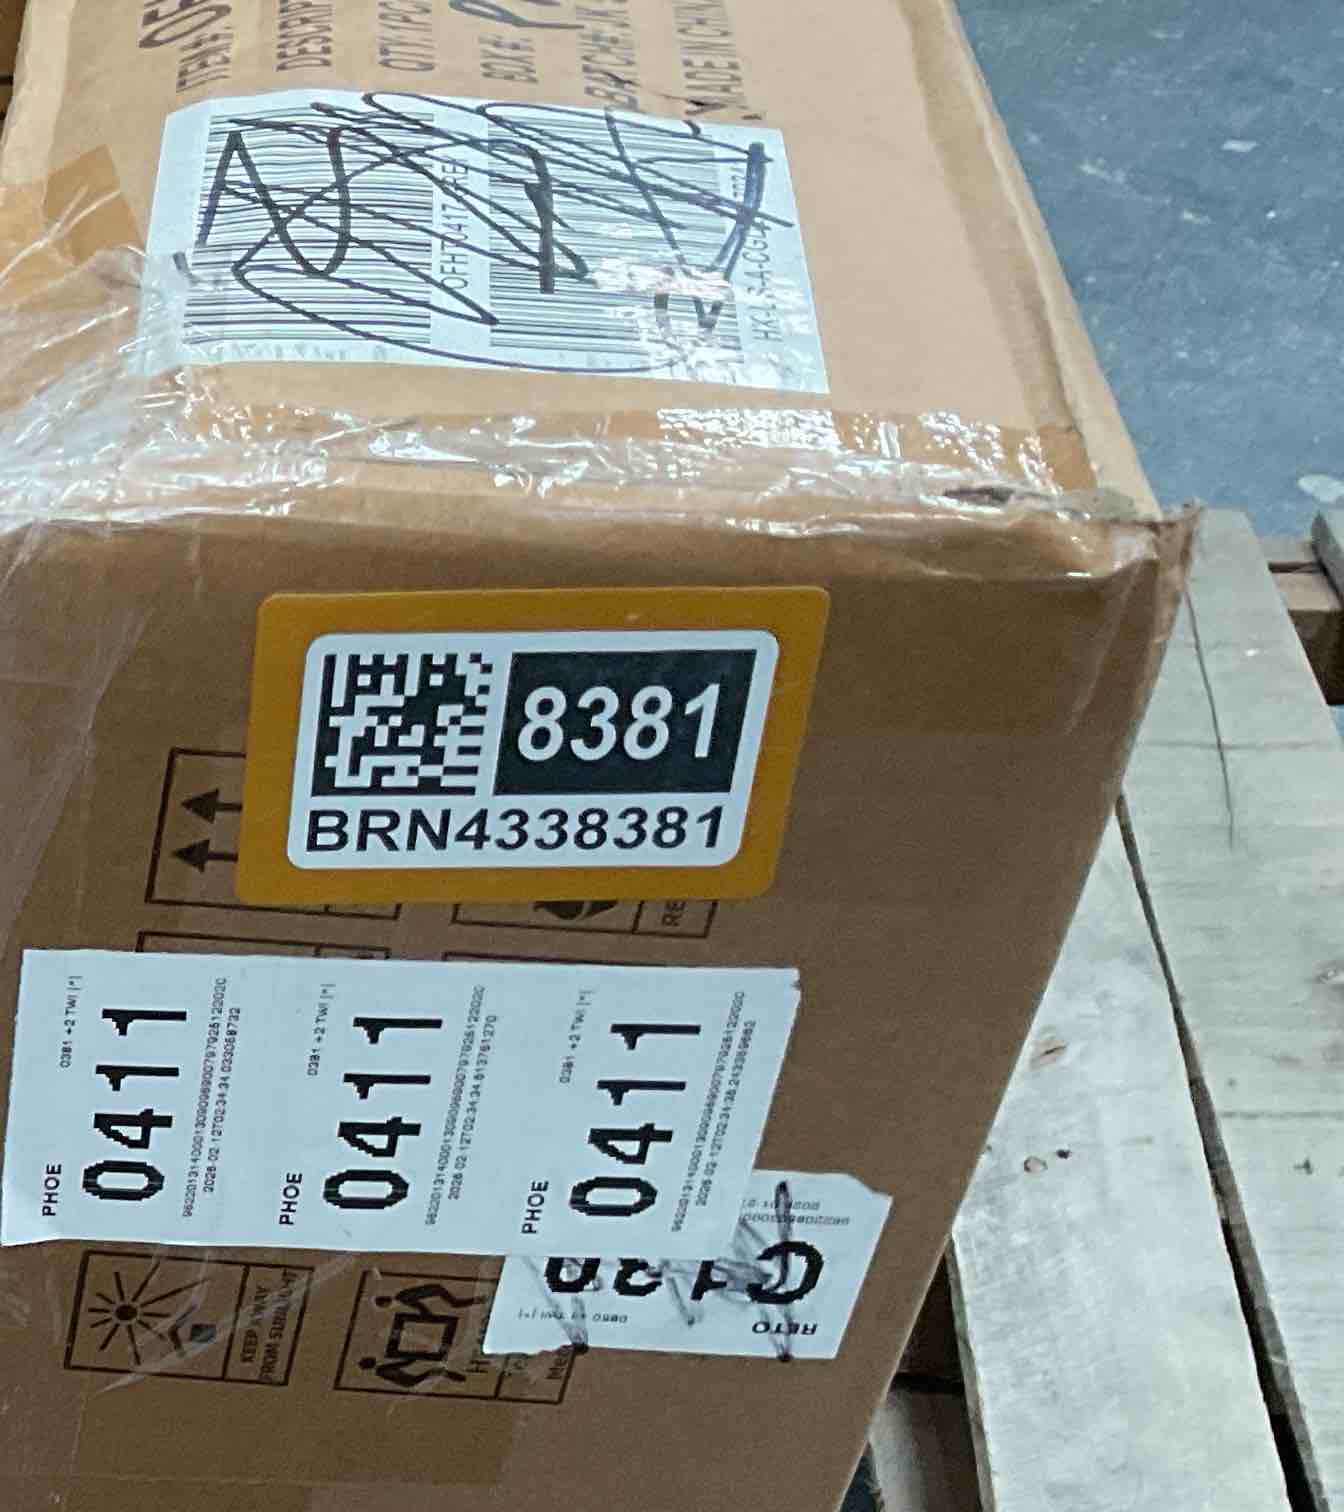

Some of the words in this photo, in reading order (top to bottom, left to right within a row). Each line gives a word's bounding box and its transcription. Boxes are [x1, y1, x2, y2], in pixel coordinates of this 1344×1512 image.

[517, 683, 720, 761] 8381
[305, 806, 725, 853] BRN4338381
[82, 1008, 187, 1202] 0411
[323, 1016, 442, 1213] 0411
[570, 1024, 701, 1218] 0411
[41, 1162, 62, 1217] PHOE
[278, 1172, 302, 1229] PHOE
[521, 1178, 546, 1236] PHOE
